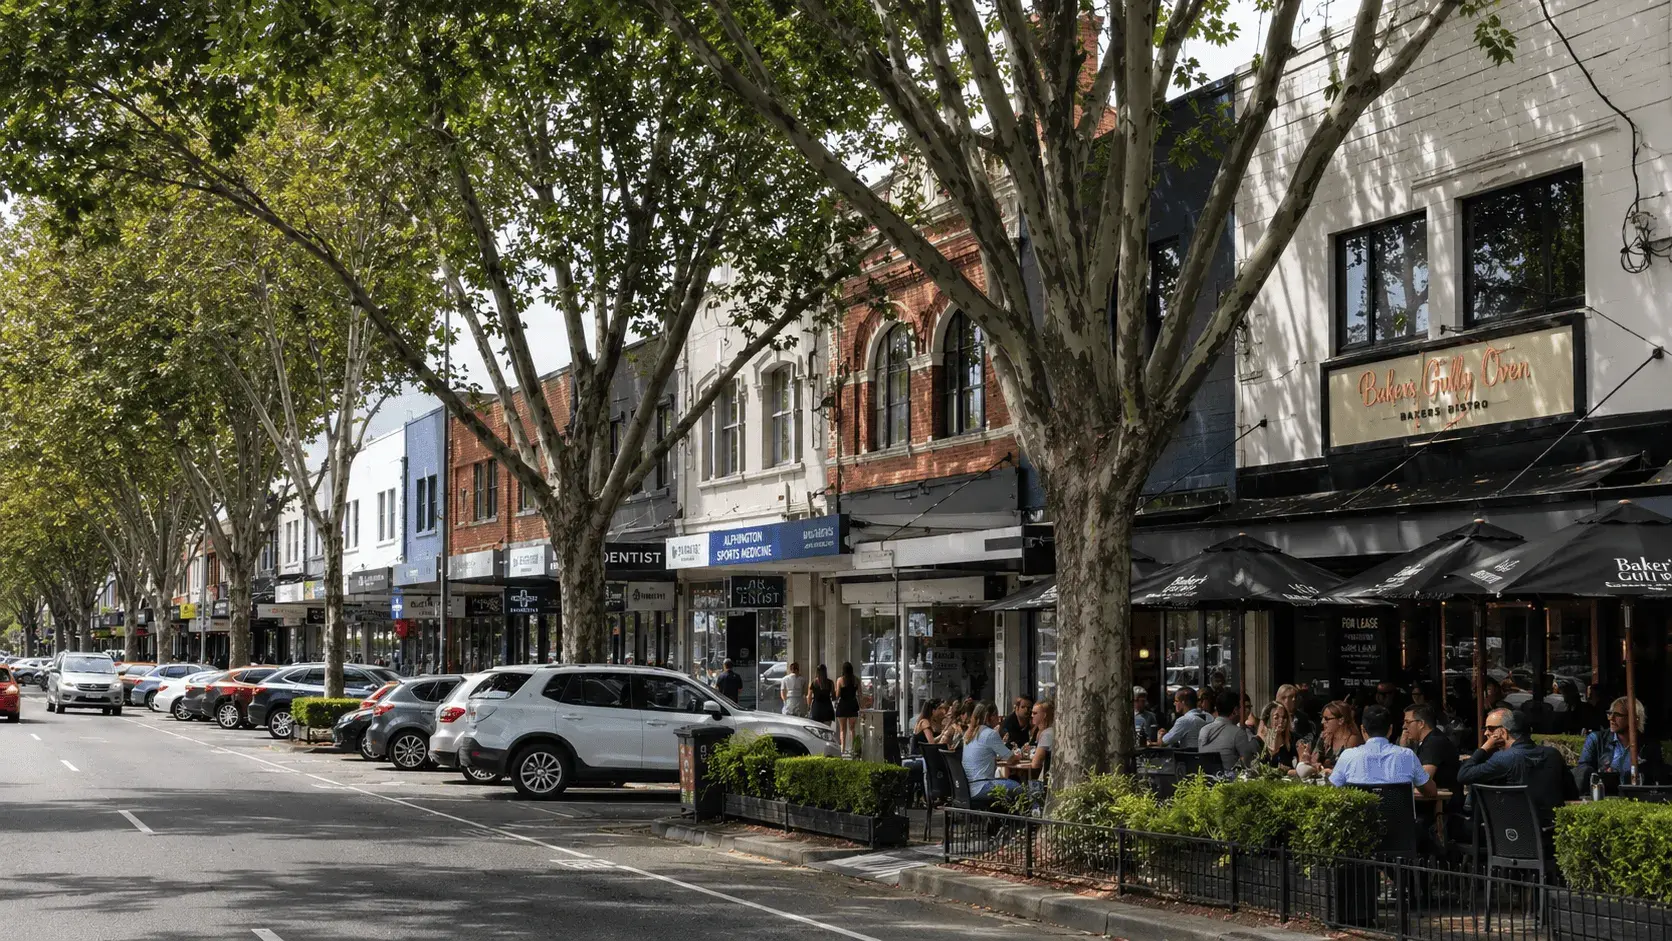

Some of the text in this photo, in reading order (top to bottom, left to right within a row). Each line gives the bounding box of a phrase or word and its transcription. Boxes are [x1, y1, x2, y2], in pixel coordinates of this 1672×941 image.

[1422, 354, 1473, 401] Gully
[1481, 346, 1531, 387] Oven
[1400, 406, 1441, 421] BAKERS
